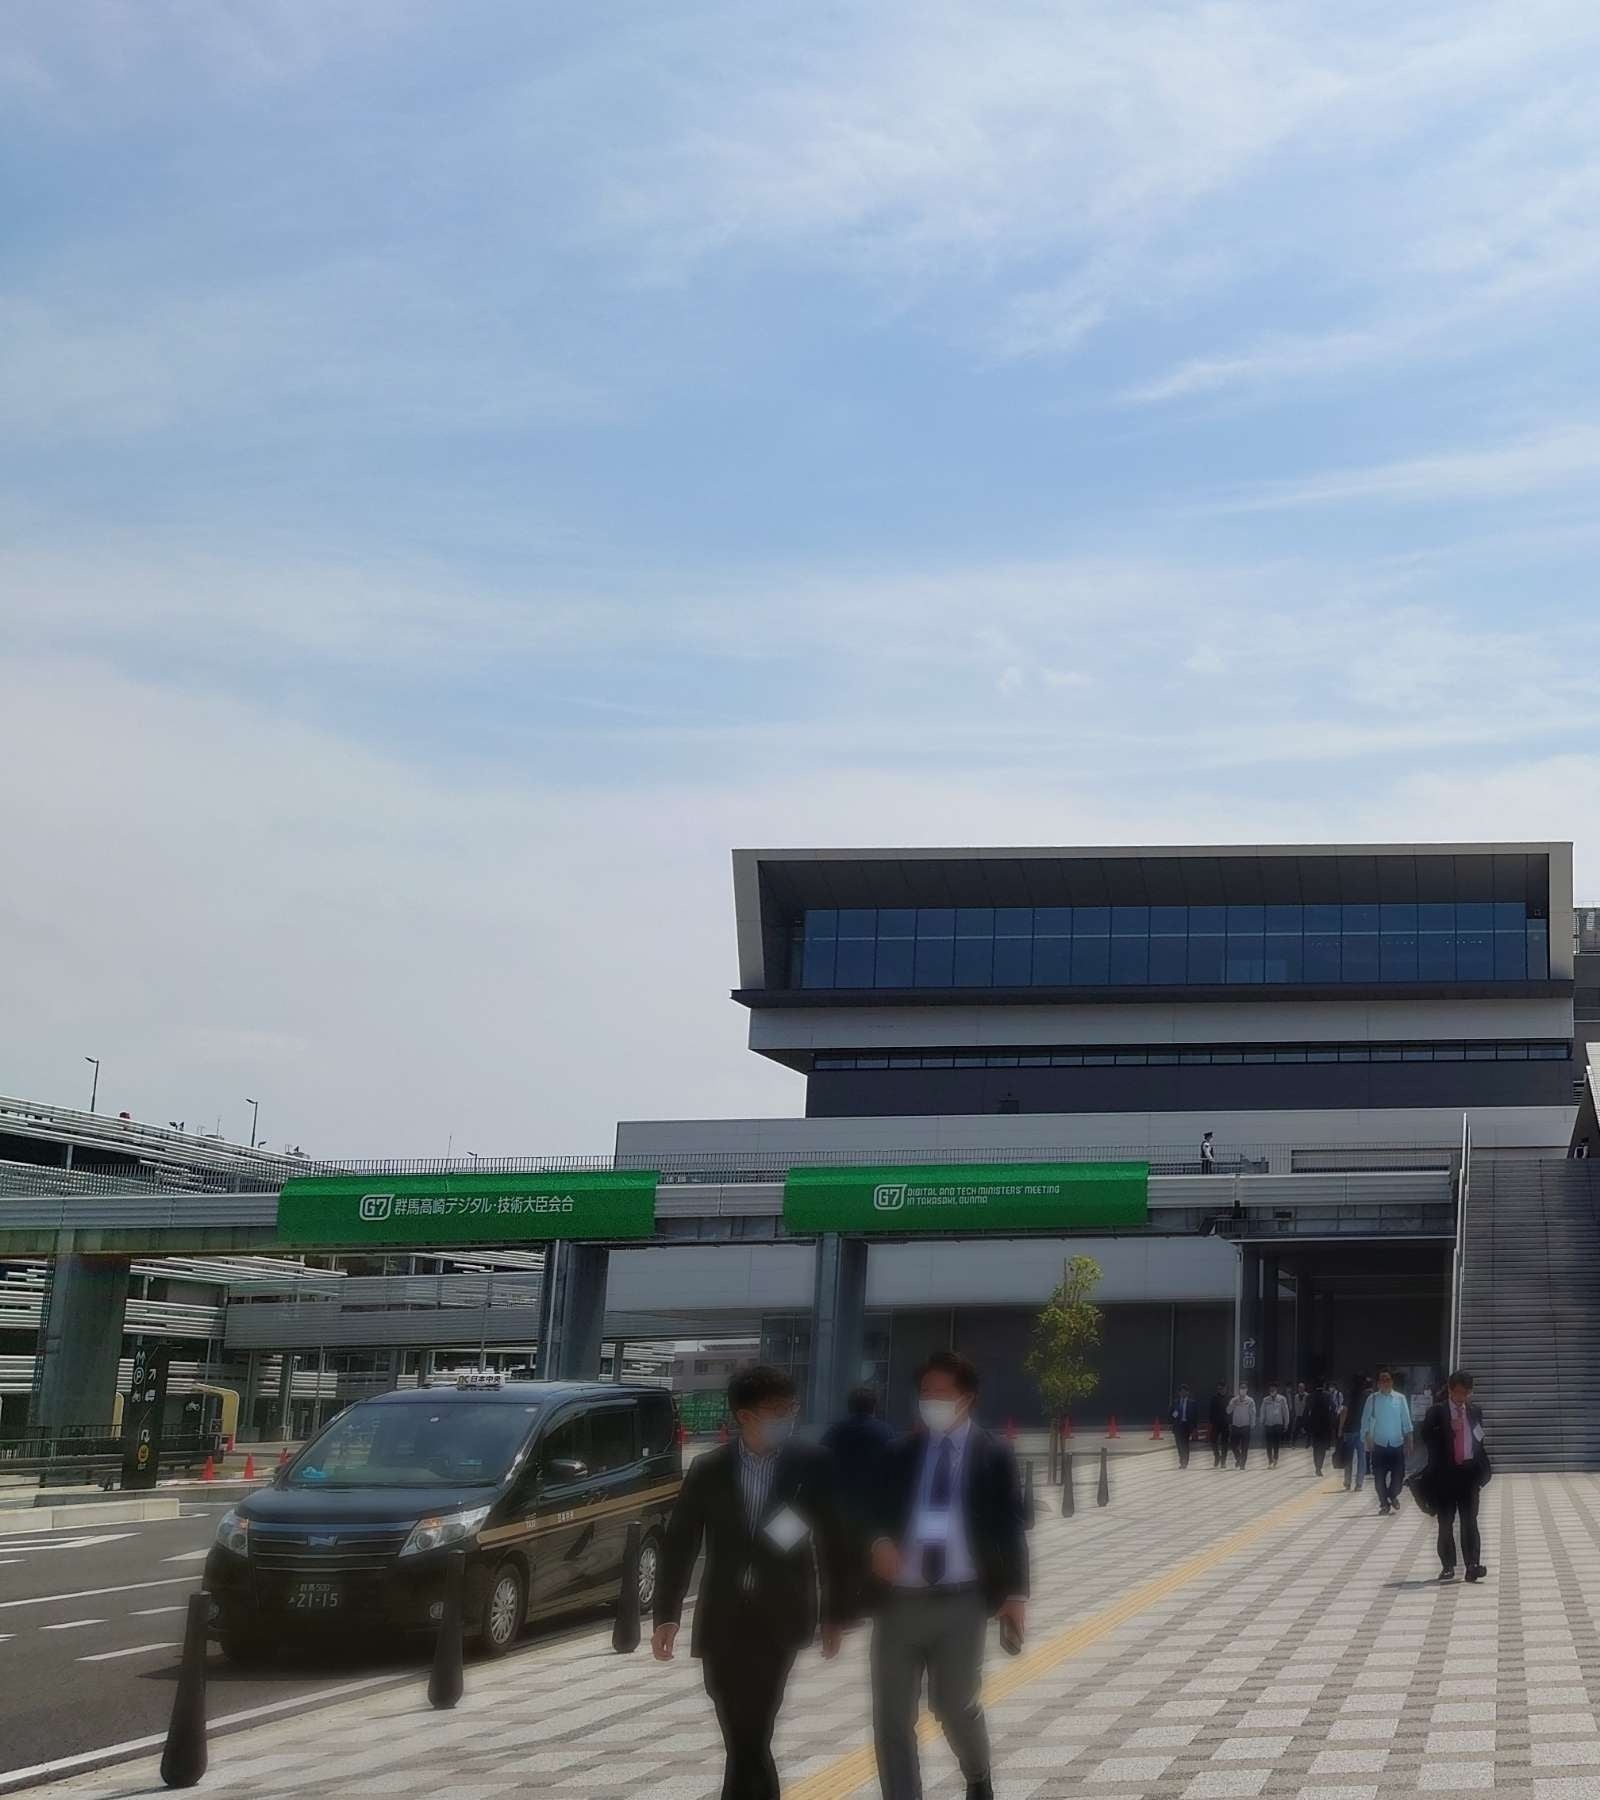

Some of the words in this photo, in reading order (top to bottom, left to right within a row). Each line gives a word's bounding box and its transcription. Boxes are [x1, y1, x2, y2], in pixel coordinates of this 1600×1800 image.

[877, 1187, 901, 1206] G7
[907, 1187, 938, 1196] DIGITAL
[939, 1187, 955, 1196] AND
[956, 1186, 977, 1196] TECH
[1024, 1184, 1060, 1195] MEETING
[906, 1197, 915, 1206] IN
[959, 1195, 988, 1205] GUNMA
[363, 1197, 388, 1217] G7
[297, 1593, 338, 1608] 21-15
